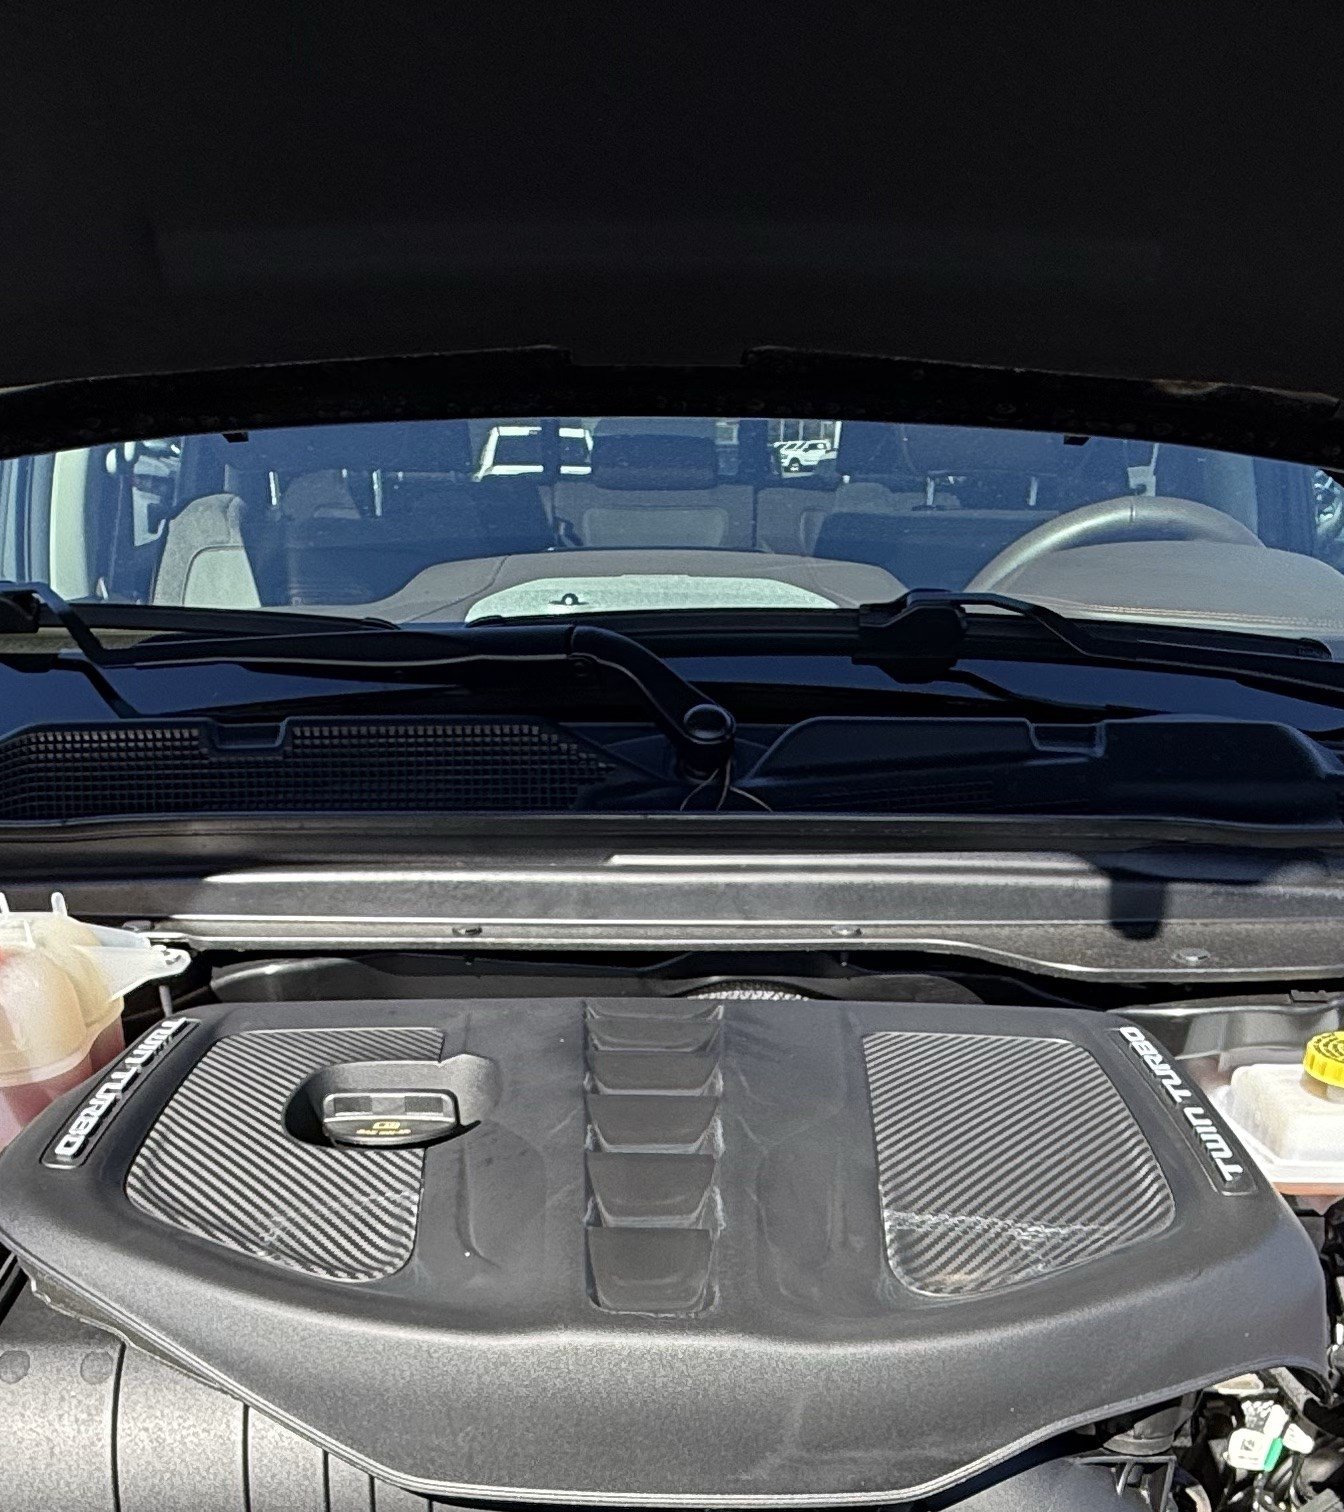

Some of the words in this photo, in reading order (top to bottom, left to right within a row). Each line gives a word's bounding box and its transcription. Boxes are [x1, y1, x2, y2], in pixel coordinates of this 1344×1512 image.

[125, 1017, 187, 1067] TWIN
[1120, 1026, 1192, 1103] TURBO
[55, 1066, 139, 1158] TURBO
[1183, 1107, 1244, 1182] TWIN
